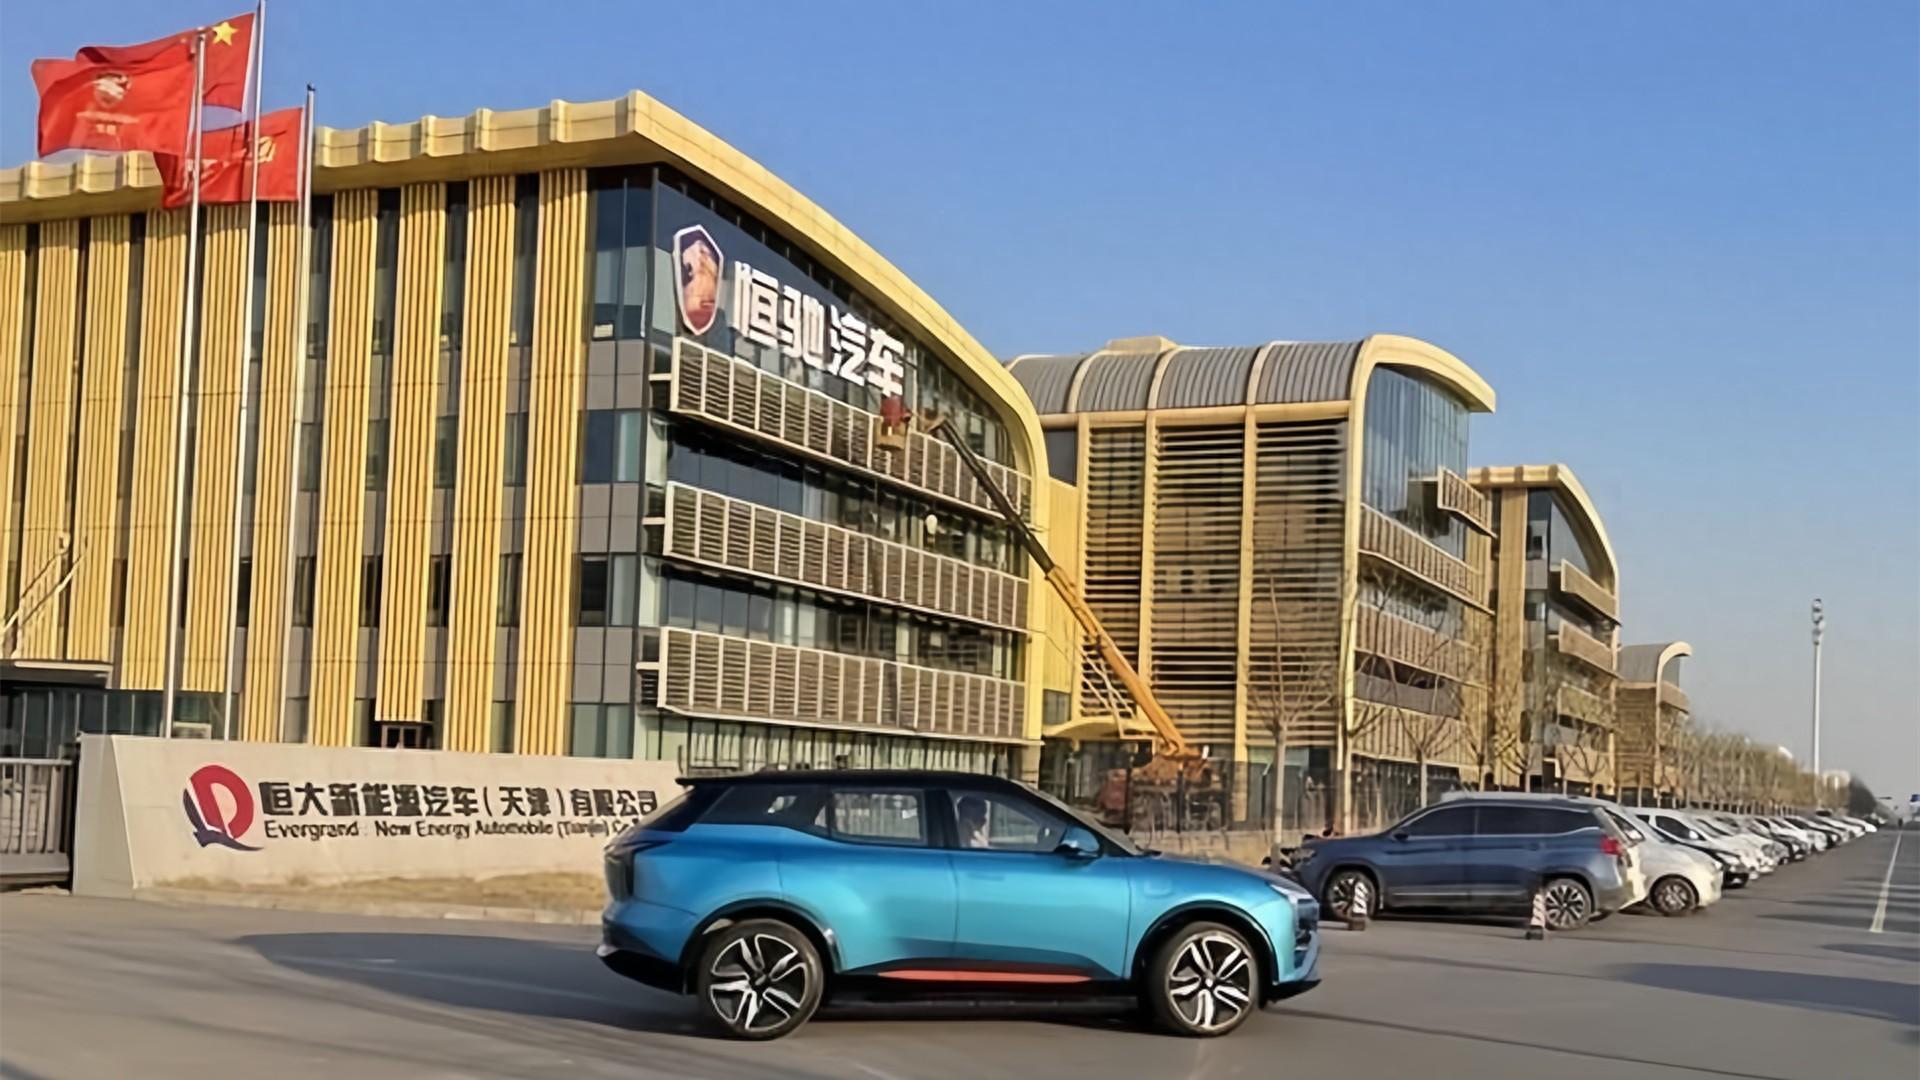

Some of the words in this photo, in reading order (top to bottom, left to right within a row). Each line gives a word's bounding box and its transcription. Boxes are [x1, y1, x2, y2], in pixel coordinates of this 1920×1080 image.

[734, 260, 905, 398] 恒驰汽车
[375, 820, 412, 837] New
[416, 820, 471, 839] Energy
[474, 819, 553, 836] Automobile
